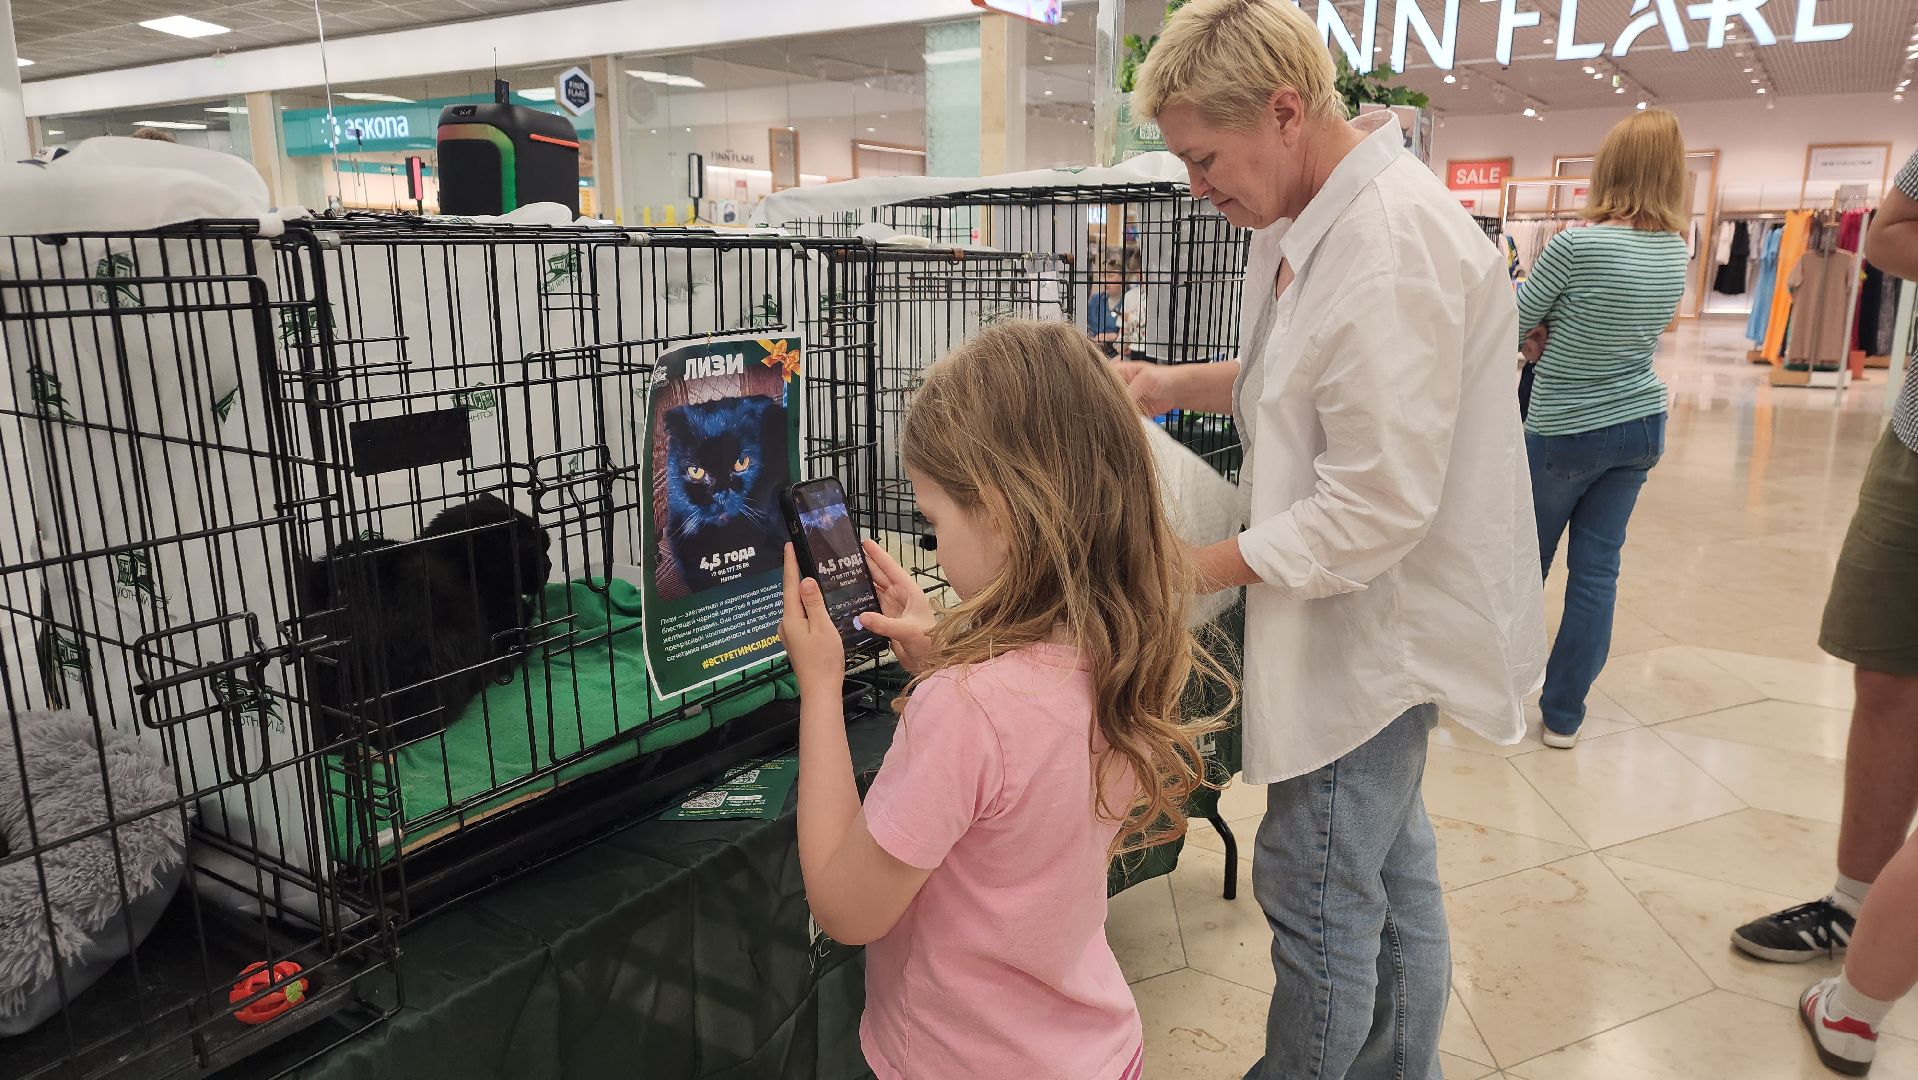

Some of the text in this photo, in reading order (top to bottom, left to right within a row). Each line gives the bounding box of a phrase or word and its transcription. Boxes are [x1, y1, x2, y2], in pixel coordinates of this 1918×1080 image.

[1296, 0, 1460, 75] NN
[345, 115, 409, 140] askona
[1456, 167, 1500, 185] SALE
[684, 353, 744, 381] ЛИЗИ
[700, 547, 756, 572] 4,5 года
[702, 635, 780, 669] #ВСТРЕТИМСЯДОМ
